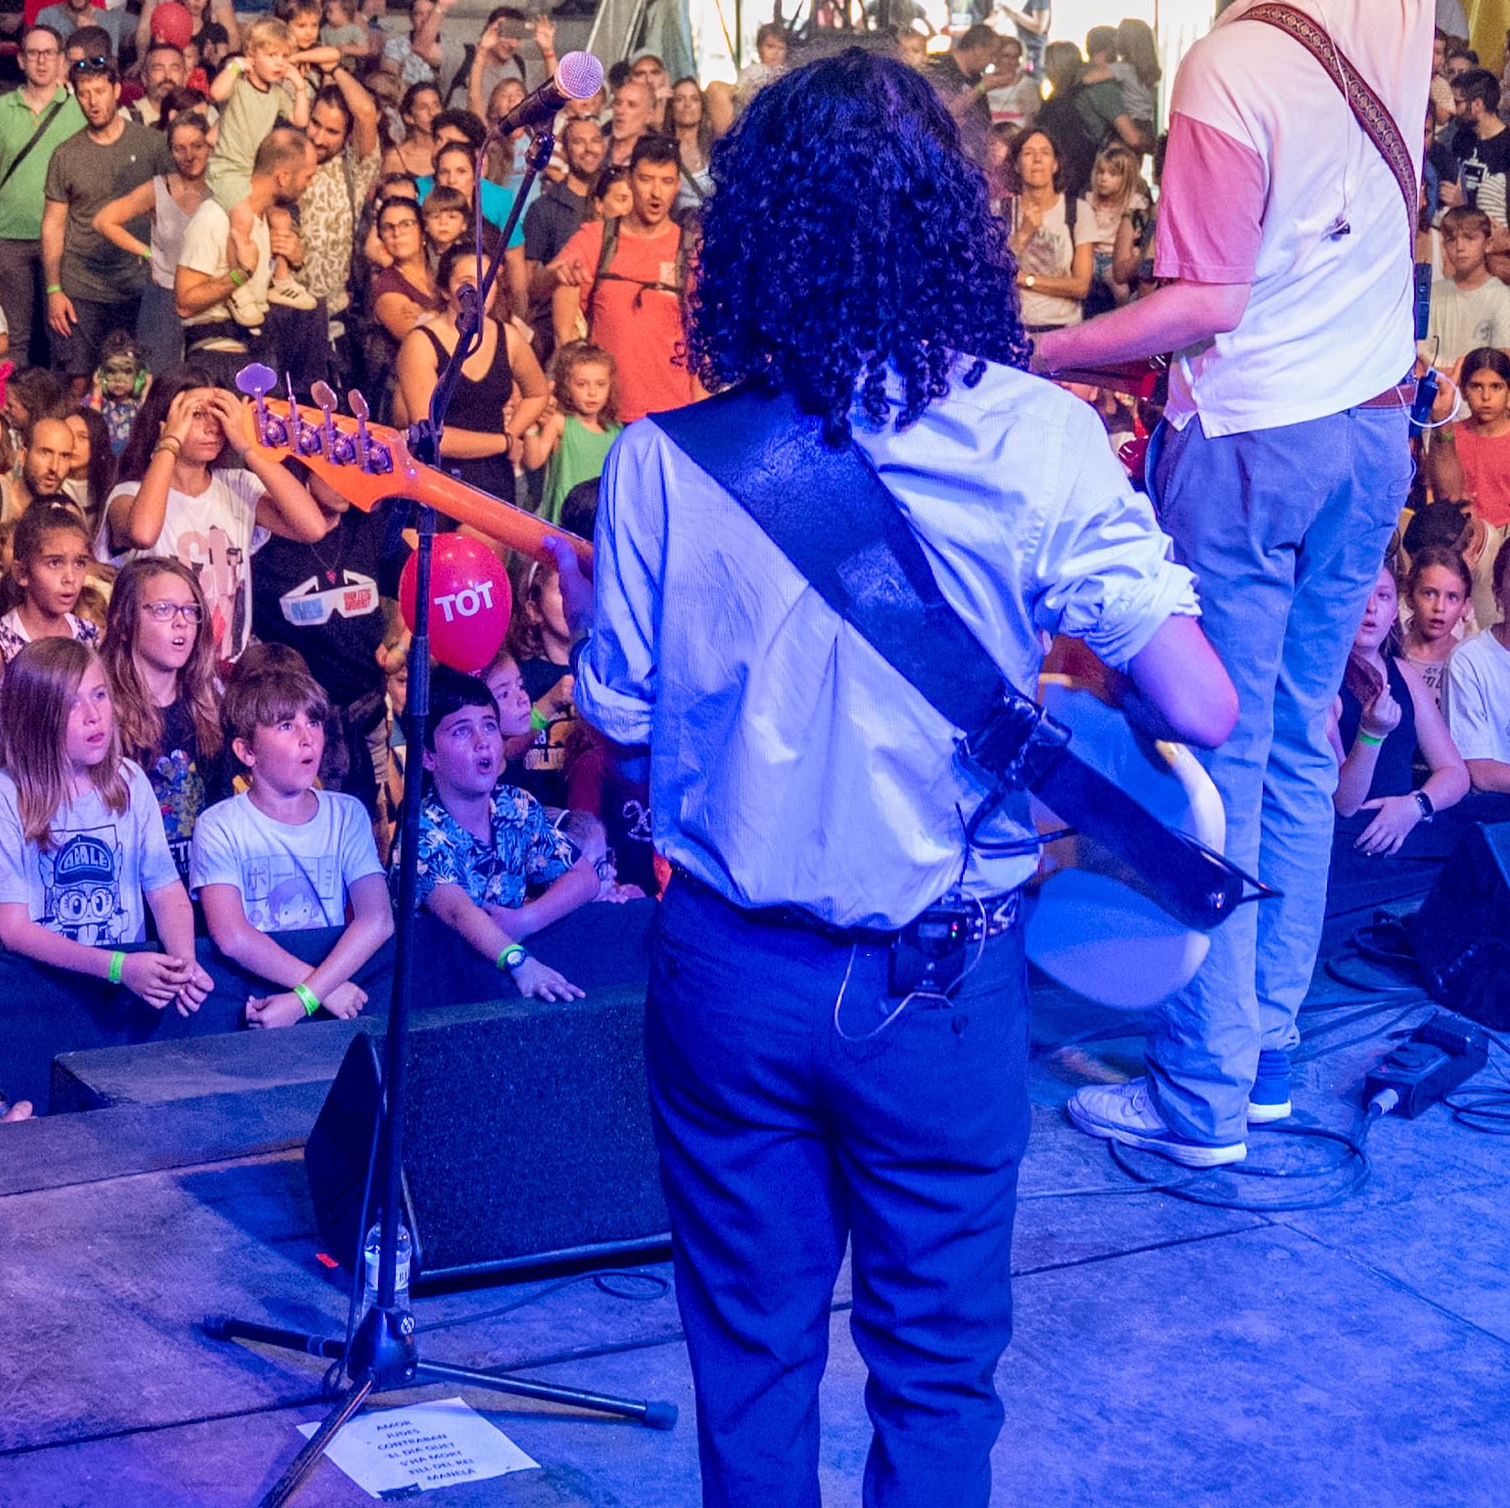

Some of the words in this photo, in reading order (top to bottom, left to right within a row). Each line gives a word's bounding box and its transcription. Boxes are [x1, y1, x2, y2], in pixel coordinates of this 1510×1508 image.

[434, 580, 494, 623] TOT
[377, 1420, 412, 1431] AMOR
[386, 1429, 420, 1439] JUDES
[402, 1448, 424, 1456] DIA
[428, 1450, 463, 1461] MORT
[409, 1466, 433, 1476] FILL
[433, 1461, 454, 1470] DEL
